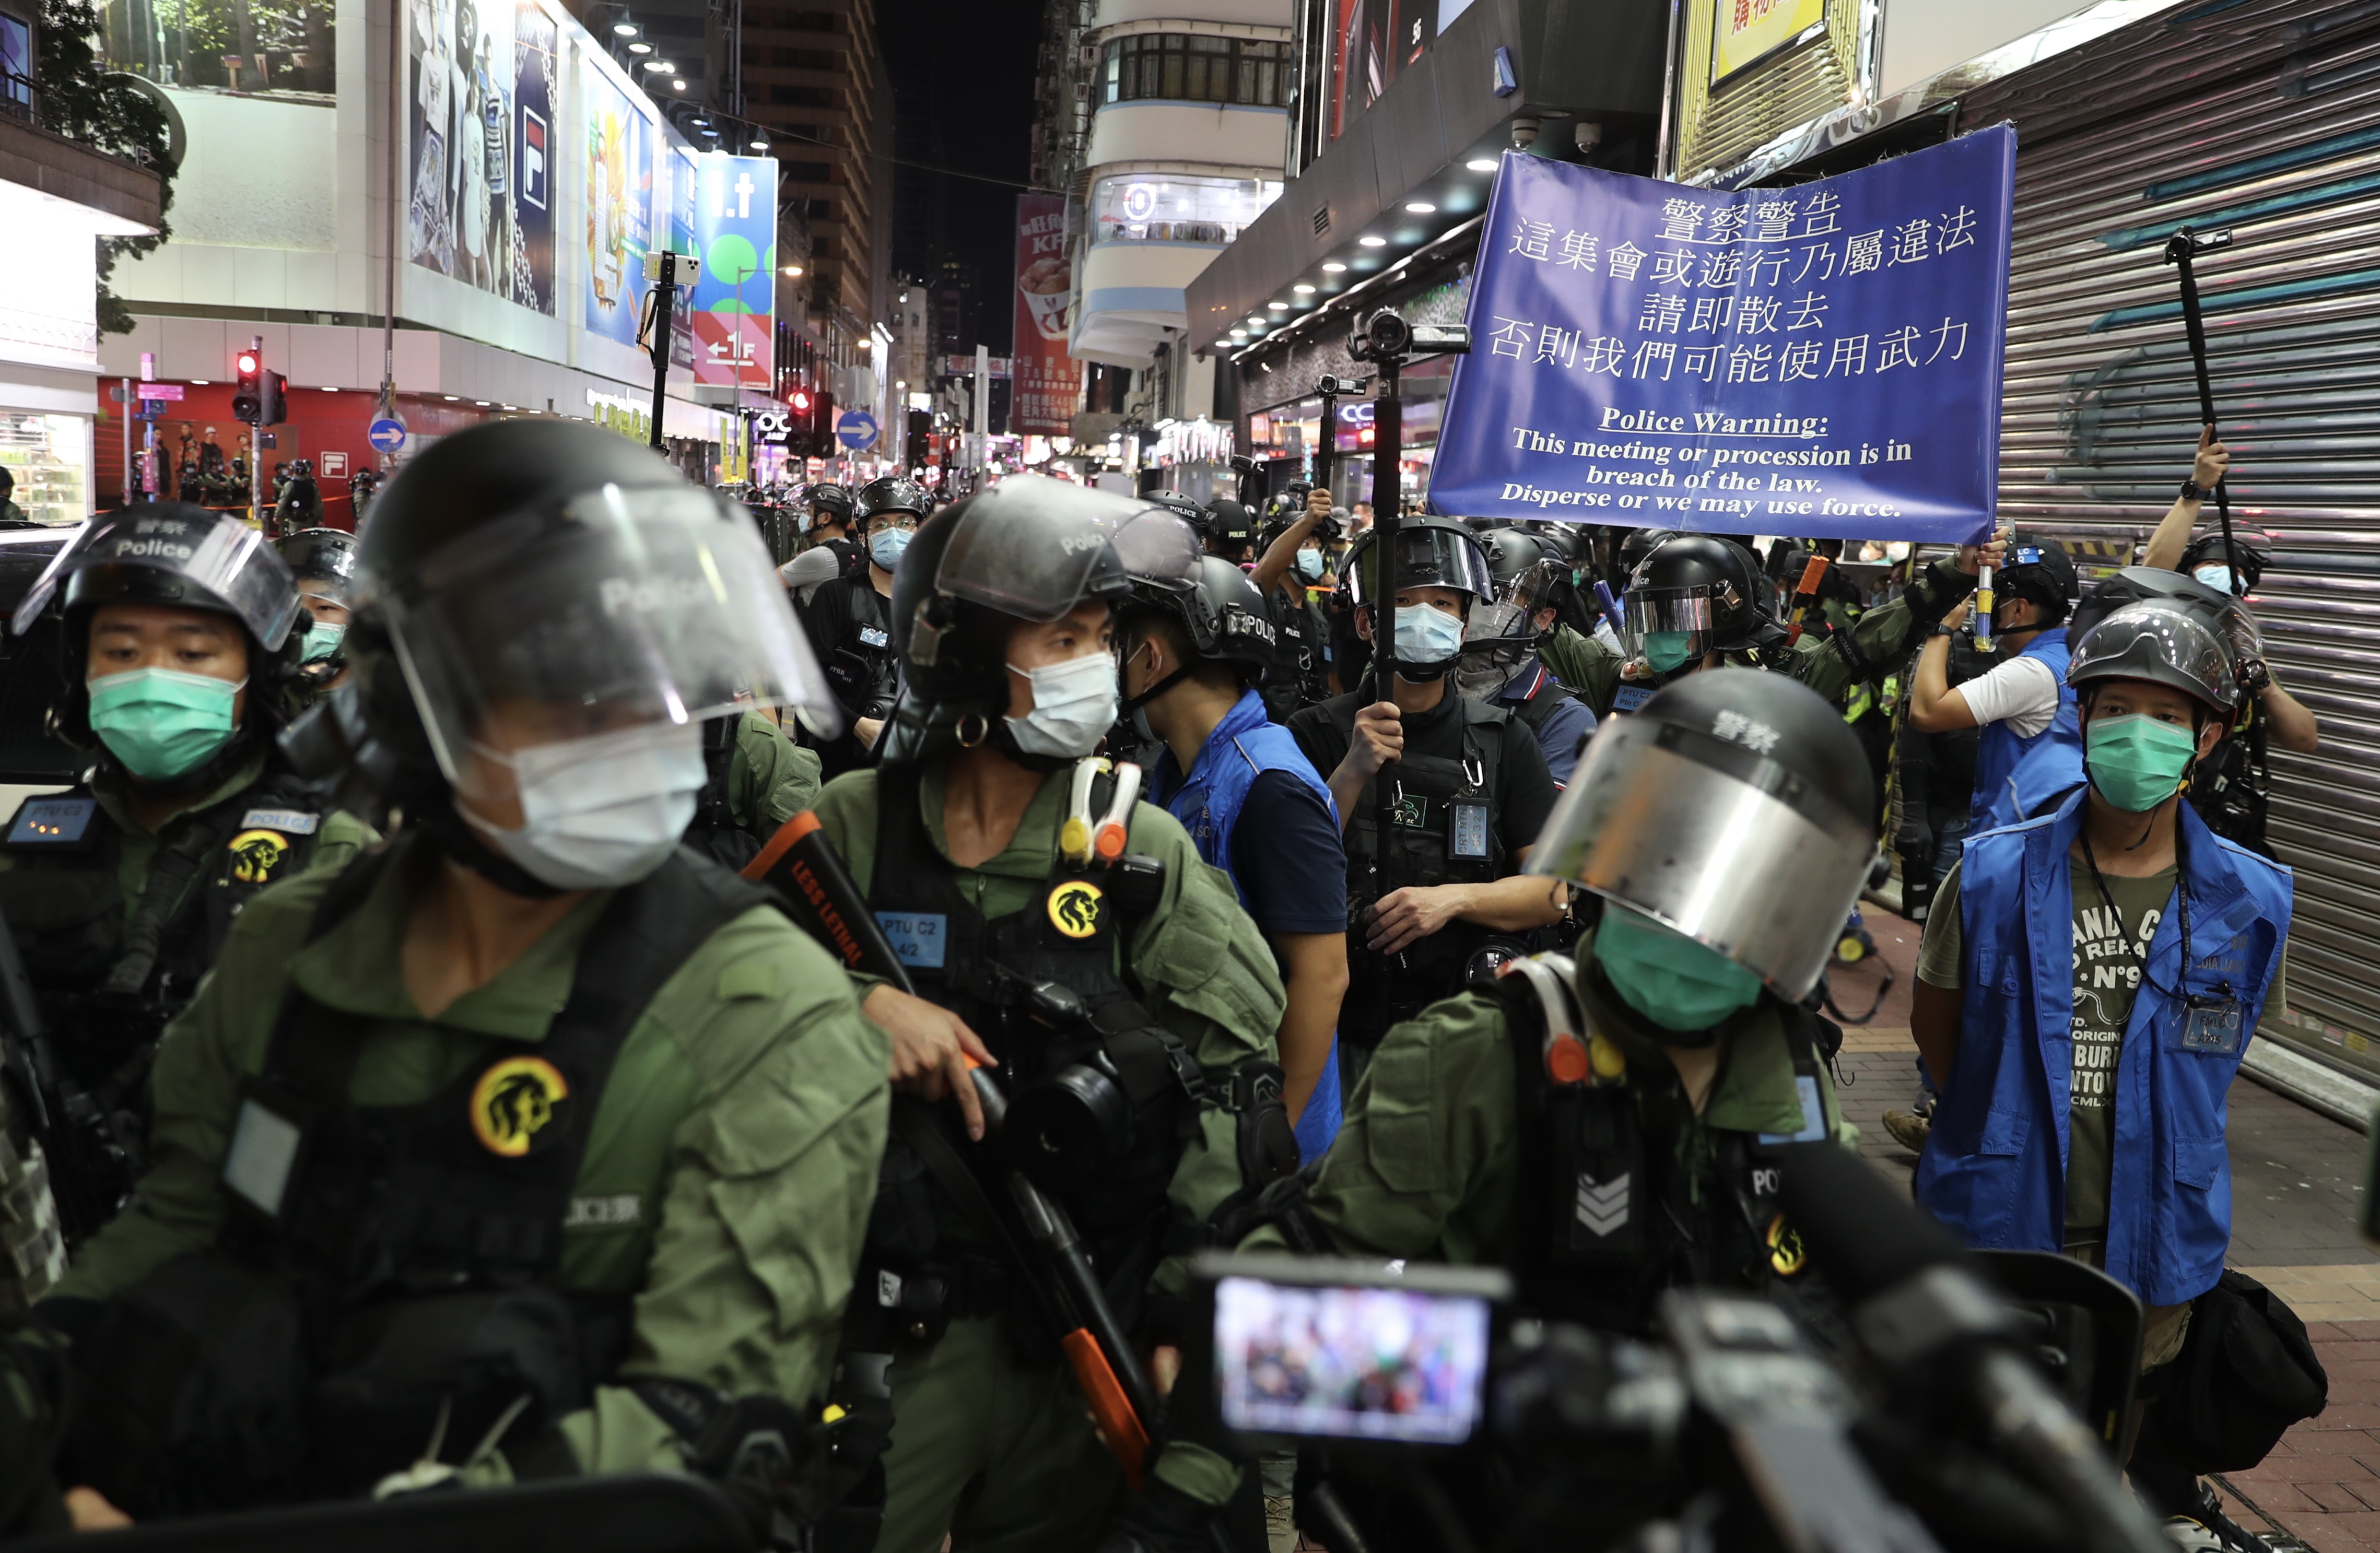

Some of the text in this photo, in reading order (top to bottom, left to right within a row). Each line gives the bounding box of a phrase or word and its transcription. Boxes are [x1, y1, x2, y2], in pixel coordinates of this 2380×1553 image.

[1656, 192, 1842, 243] 警察警告
[1032, 233, 1063, 255] KF
[1508, 205, 1977, 289] 這集會或遊行乃屬違法
[1638, 290, 1829, 335] 請即散去
[1489, 316, 1968, 384] 否則我們可能使用武力
[1600, 406, 1828, 439] Police Warning:
[1513, 427, 1912, 467] This meeting or procession is in
[1586, 465, 1823, 493] breach of the law.
[1169, 505, 1197, 518] POLICE
[1499, 483, 1901, 518] Disperse or we may use force.
[115, 538, 192, 559] Police
[1248, 615, 1276, 646] POLICE
[1285, 627, 1300, 638] POLICE
[1622, 688, 1638, 697] PTU
[1712, 709, 1781, 756] 警察
[1459, 832, 1468, 854] CRT
[791, 860, 862, 969] LESS LETHAL
[885, 920, 937, 935] PTU C2
[897, 944, 919, 957] 4/2
[2199, 1016, 2226, 1028] FMLC
[2072, 1030, 2123, 1043] ORIGIN
[2071, 1096, 2115, 1107] CMLX
